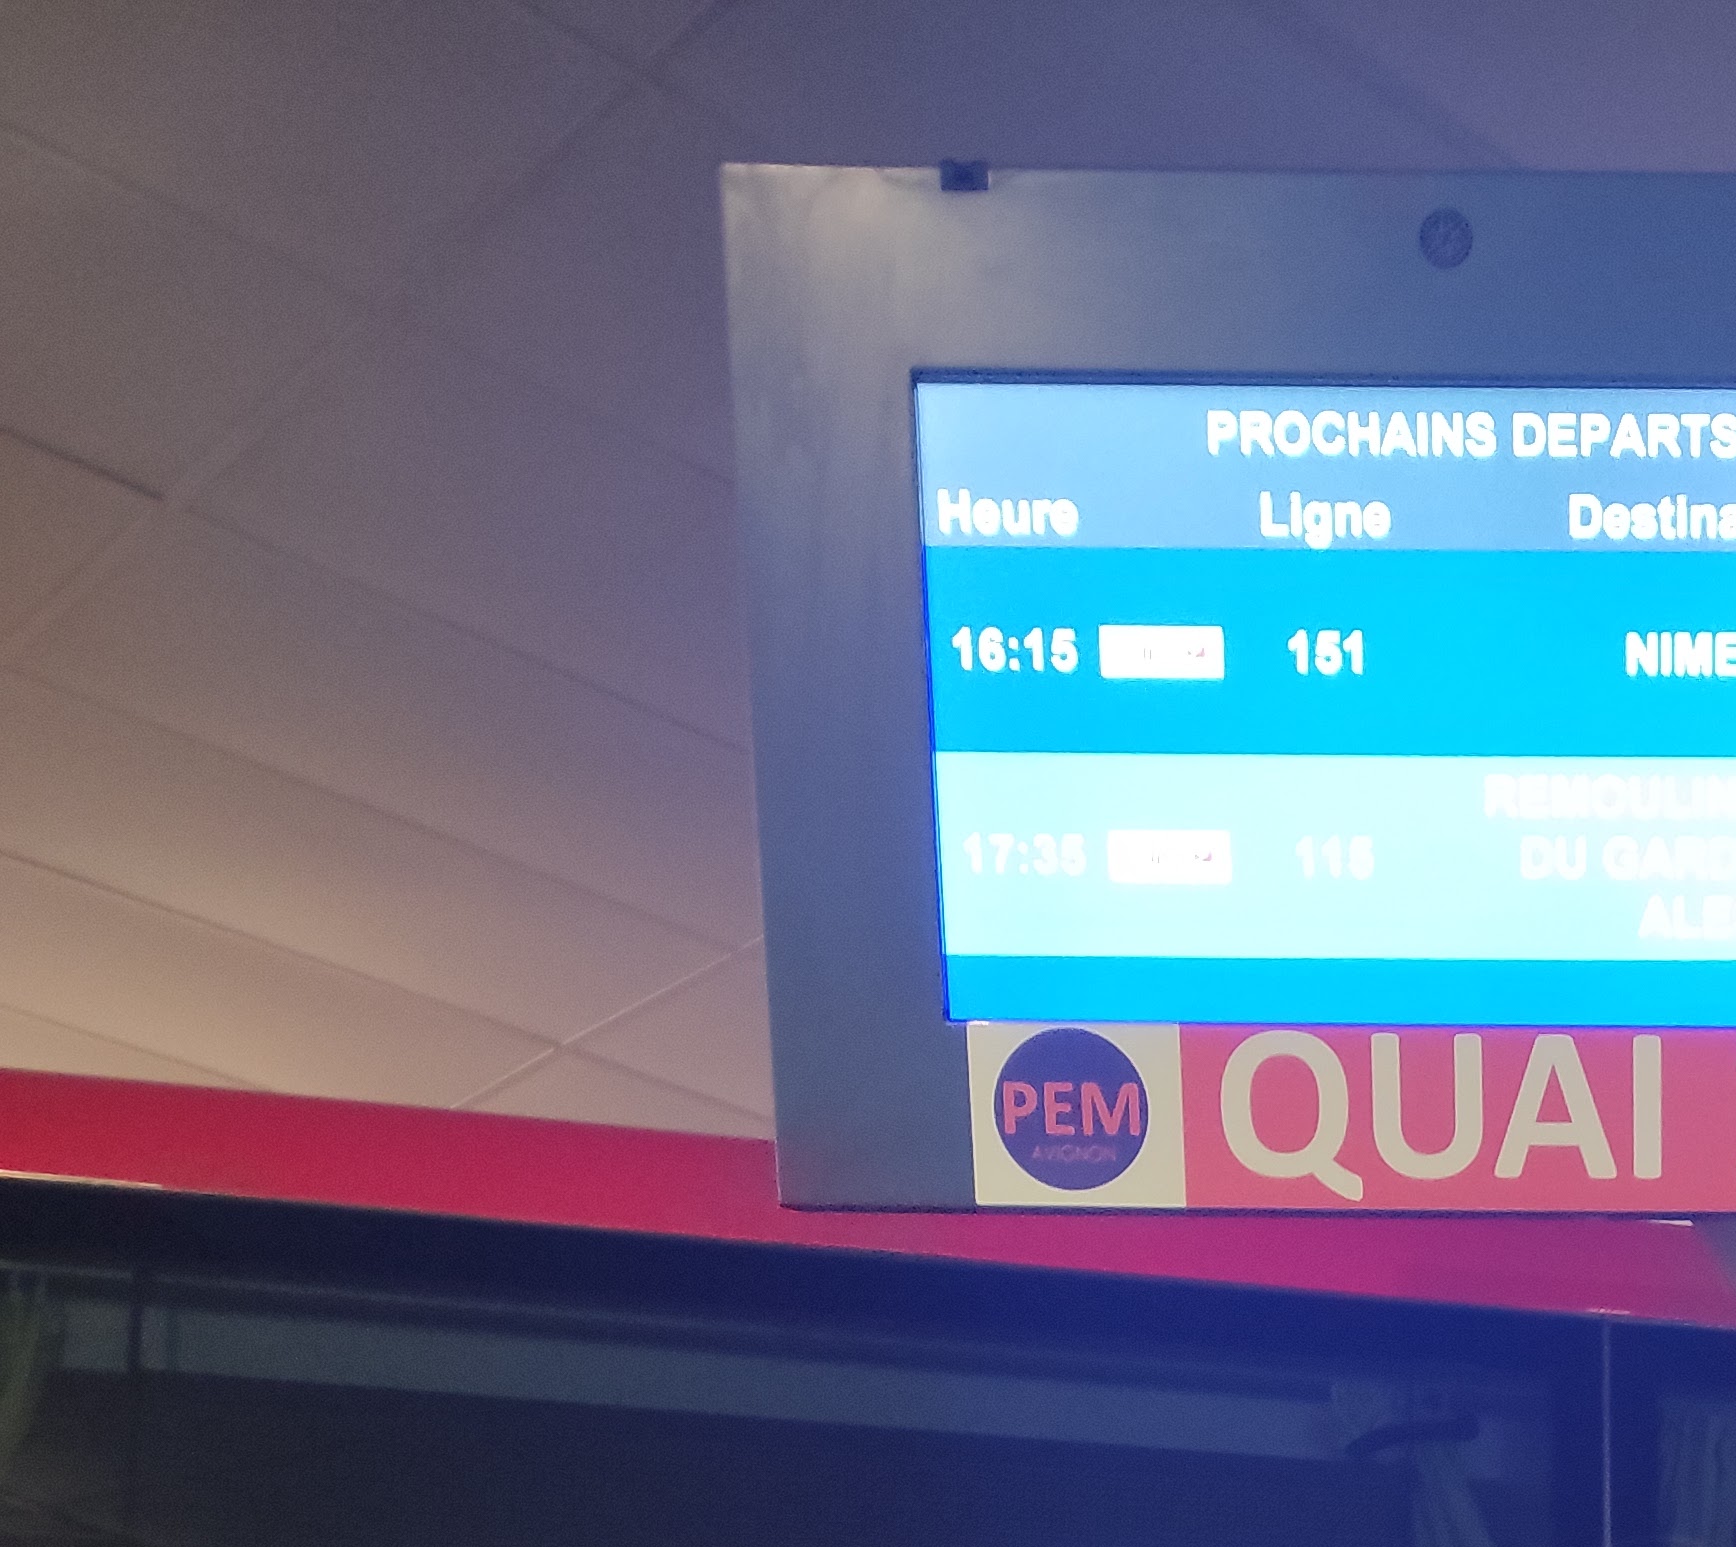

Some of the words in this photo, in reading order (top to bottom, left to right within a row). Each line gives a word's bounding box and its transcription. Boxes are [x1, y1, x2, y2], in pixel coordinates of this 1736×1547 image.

[1206, 409, 1497, 458] PROCHAINS
[937, 488, 1079, 536] Heure
[1259, 490, 1392, 549] Ligne
[951, 625, 1079, 675] 16:15
[1287, 628, 1364, 677] 151
[962, 831, 1088, 877] 17:35
[1519, 834, 1588, 881] DU
[1002, 1081, 1141, 1136] PEM
[1220, 1029, 1662, 1202] QUAI
